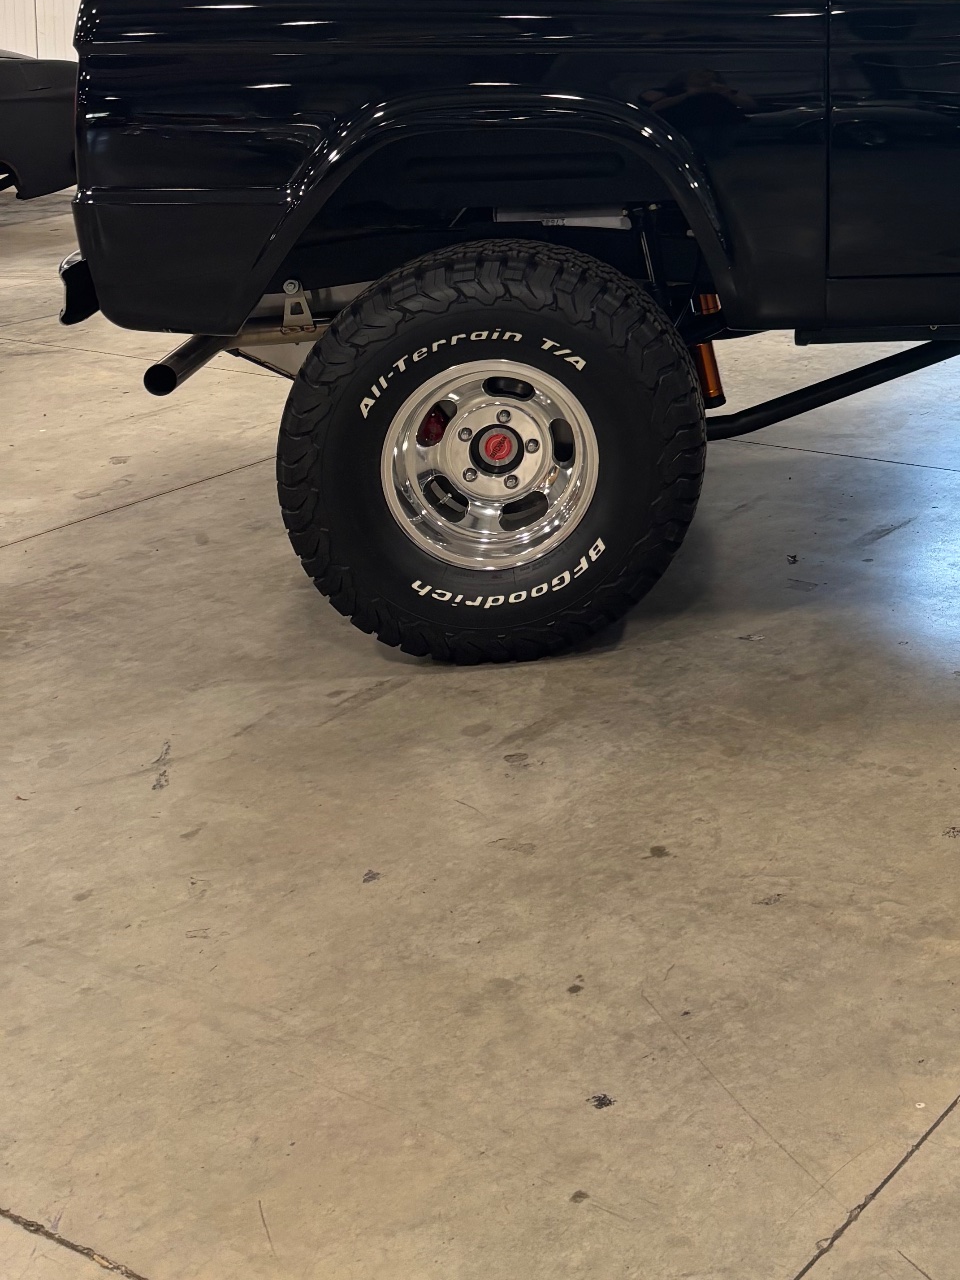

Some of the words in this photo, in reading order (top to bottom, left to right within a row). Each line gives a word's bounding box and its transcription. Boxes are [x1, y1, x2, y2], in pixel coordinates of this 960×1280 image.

[360, 329, 522, 418] All-Terrain
[541, 338, 586, 370] T/A
[412, 538, 605, 608] BFGoodrich
